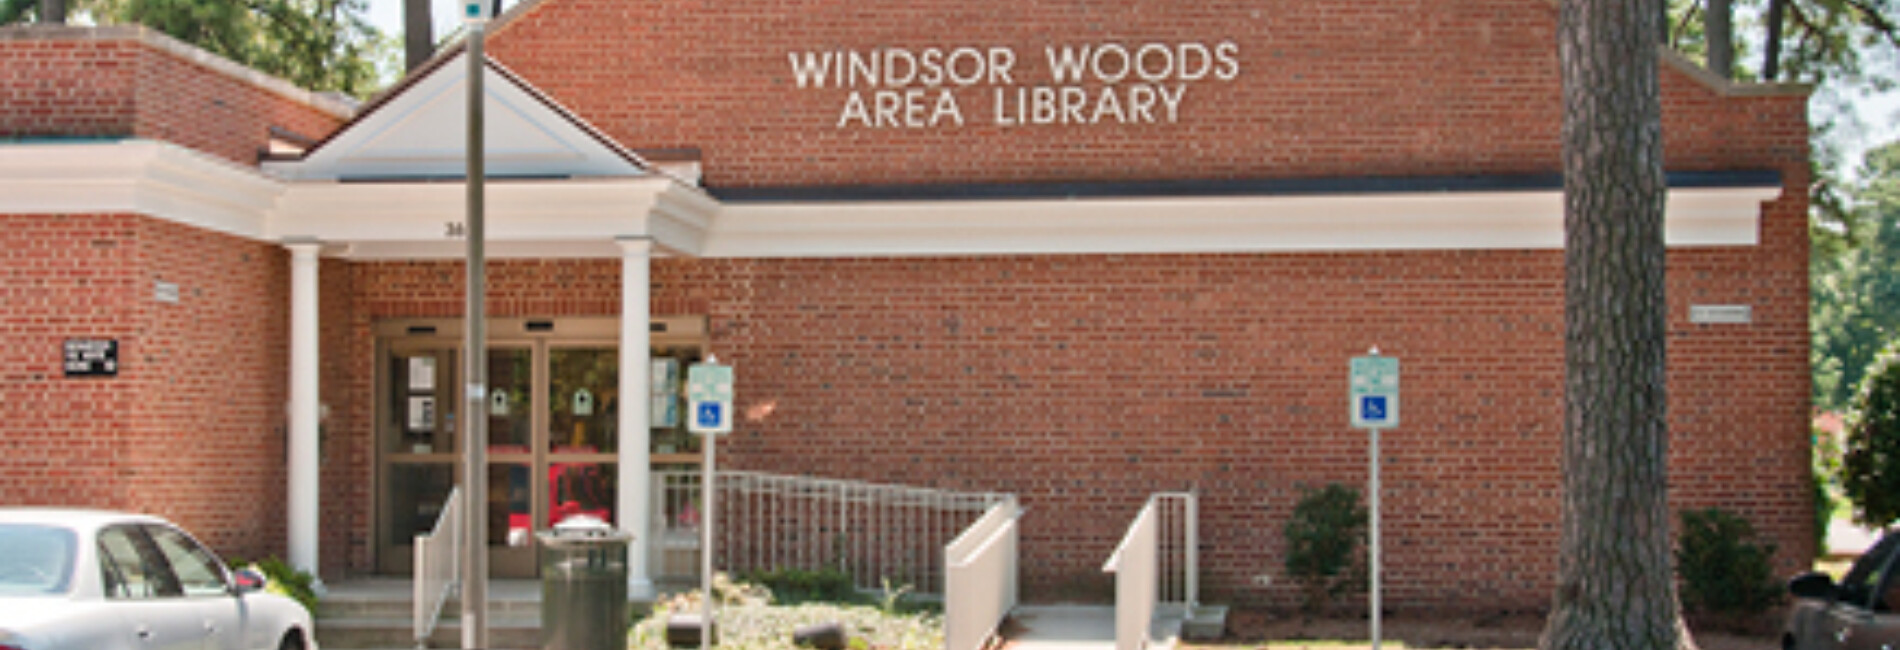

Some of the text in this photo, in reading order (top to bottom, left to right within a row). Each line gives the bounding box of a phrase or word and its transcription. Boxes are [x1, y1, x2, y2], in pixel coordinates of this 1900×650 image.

[788, 41, 1239, 88] WINDSOR WOODS
[836, 83, 1186, 128] AREA LIBRARY
